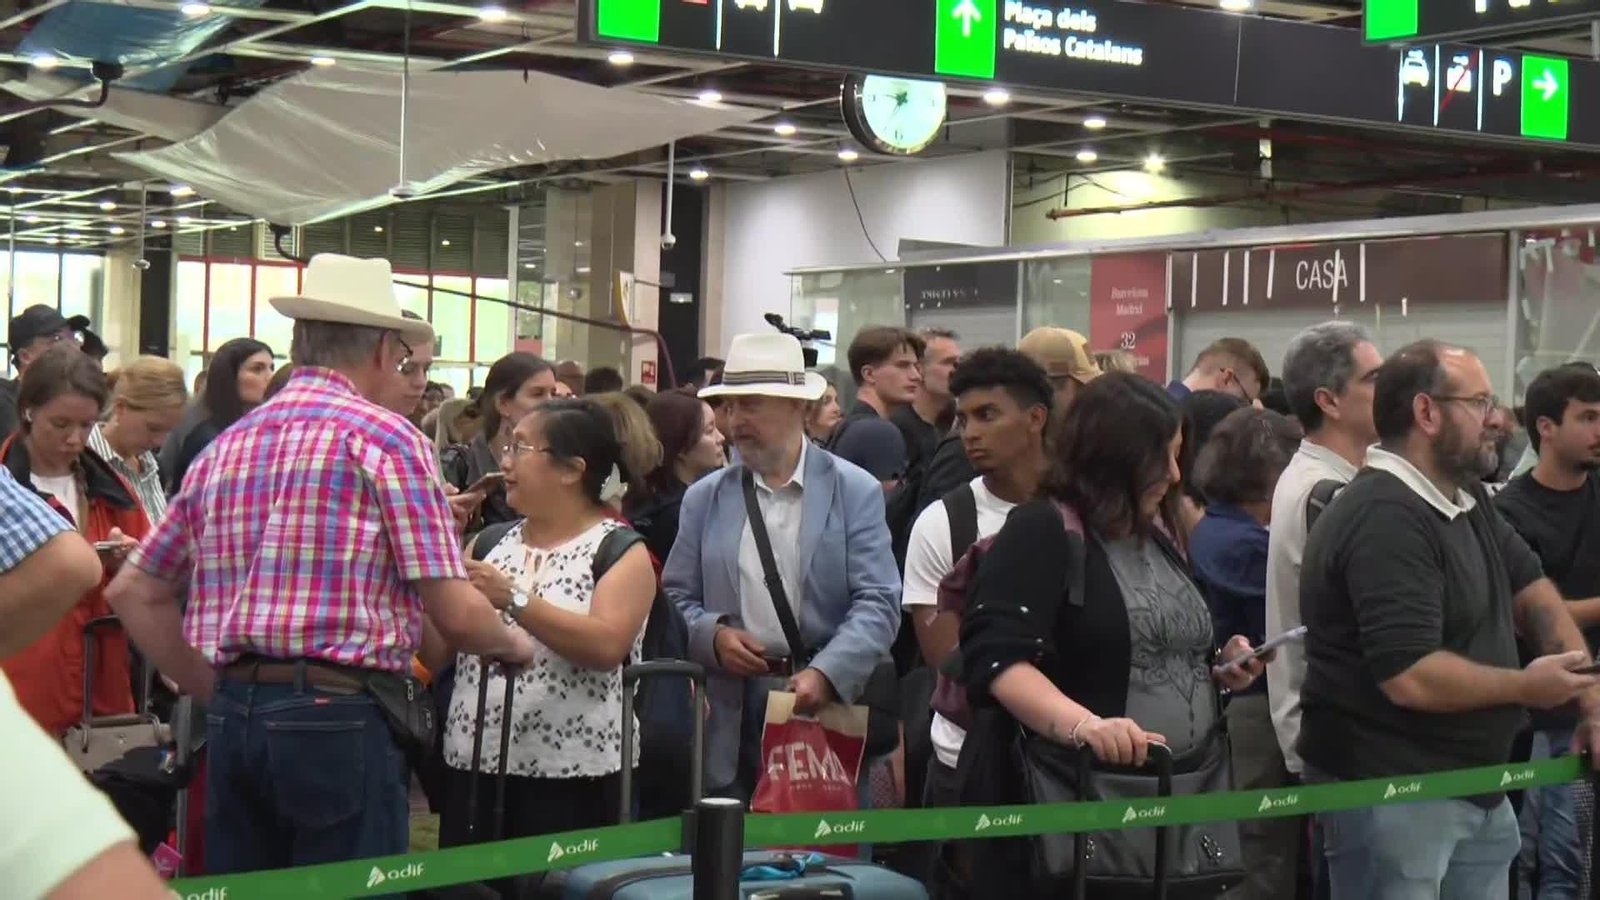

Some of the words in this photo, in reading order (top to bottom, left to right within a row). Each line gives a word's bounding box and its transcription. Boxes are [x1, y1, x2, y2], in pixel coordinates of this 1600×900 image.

[1004, 1, 1053, 29] Plaça
[1057, 8, 1097, 32] dels
[1003, 27, 1061, 55] Països
[1065, 36, 1143, 65] Catalans
[1493, 59, 1512, 95] P
[1296, 259, 1348, 290] CASA
[1116, 303, 1143, 315] Madrid
[1121, 332, 1136, 349] 32
[1512, 770, 1535, 780] adif
[1397, 782, 1421, 793] adif
[1273, 794, 1298, 806] adif
[1139, 806, 1167, 818] adif
[833, 820, 865, 833] adif
[992, 814, 1023, 826] adif
[566, 839, 598, 854] adif
[388, 863, 425, 880] adif
